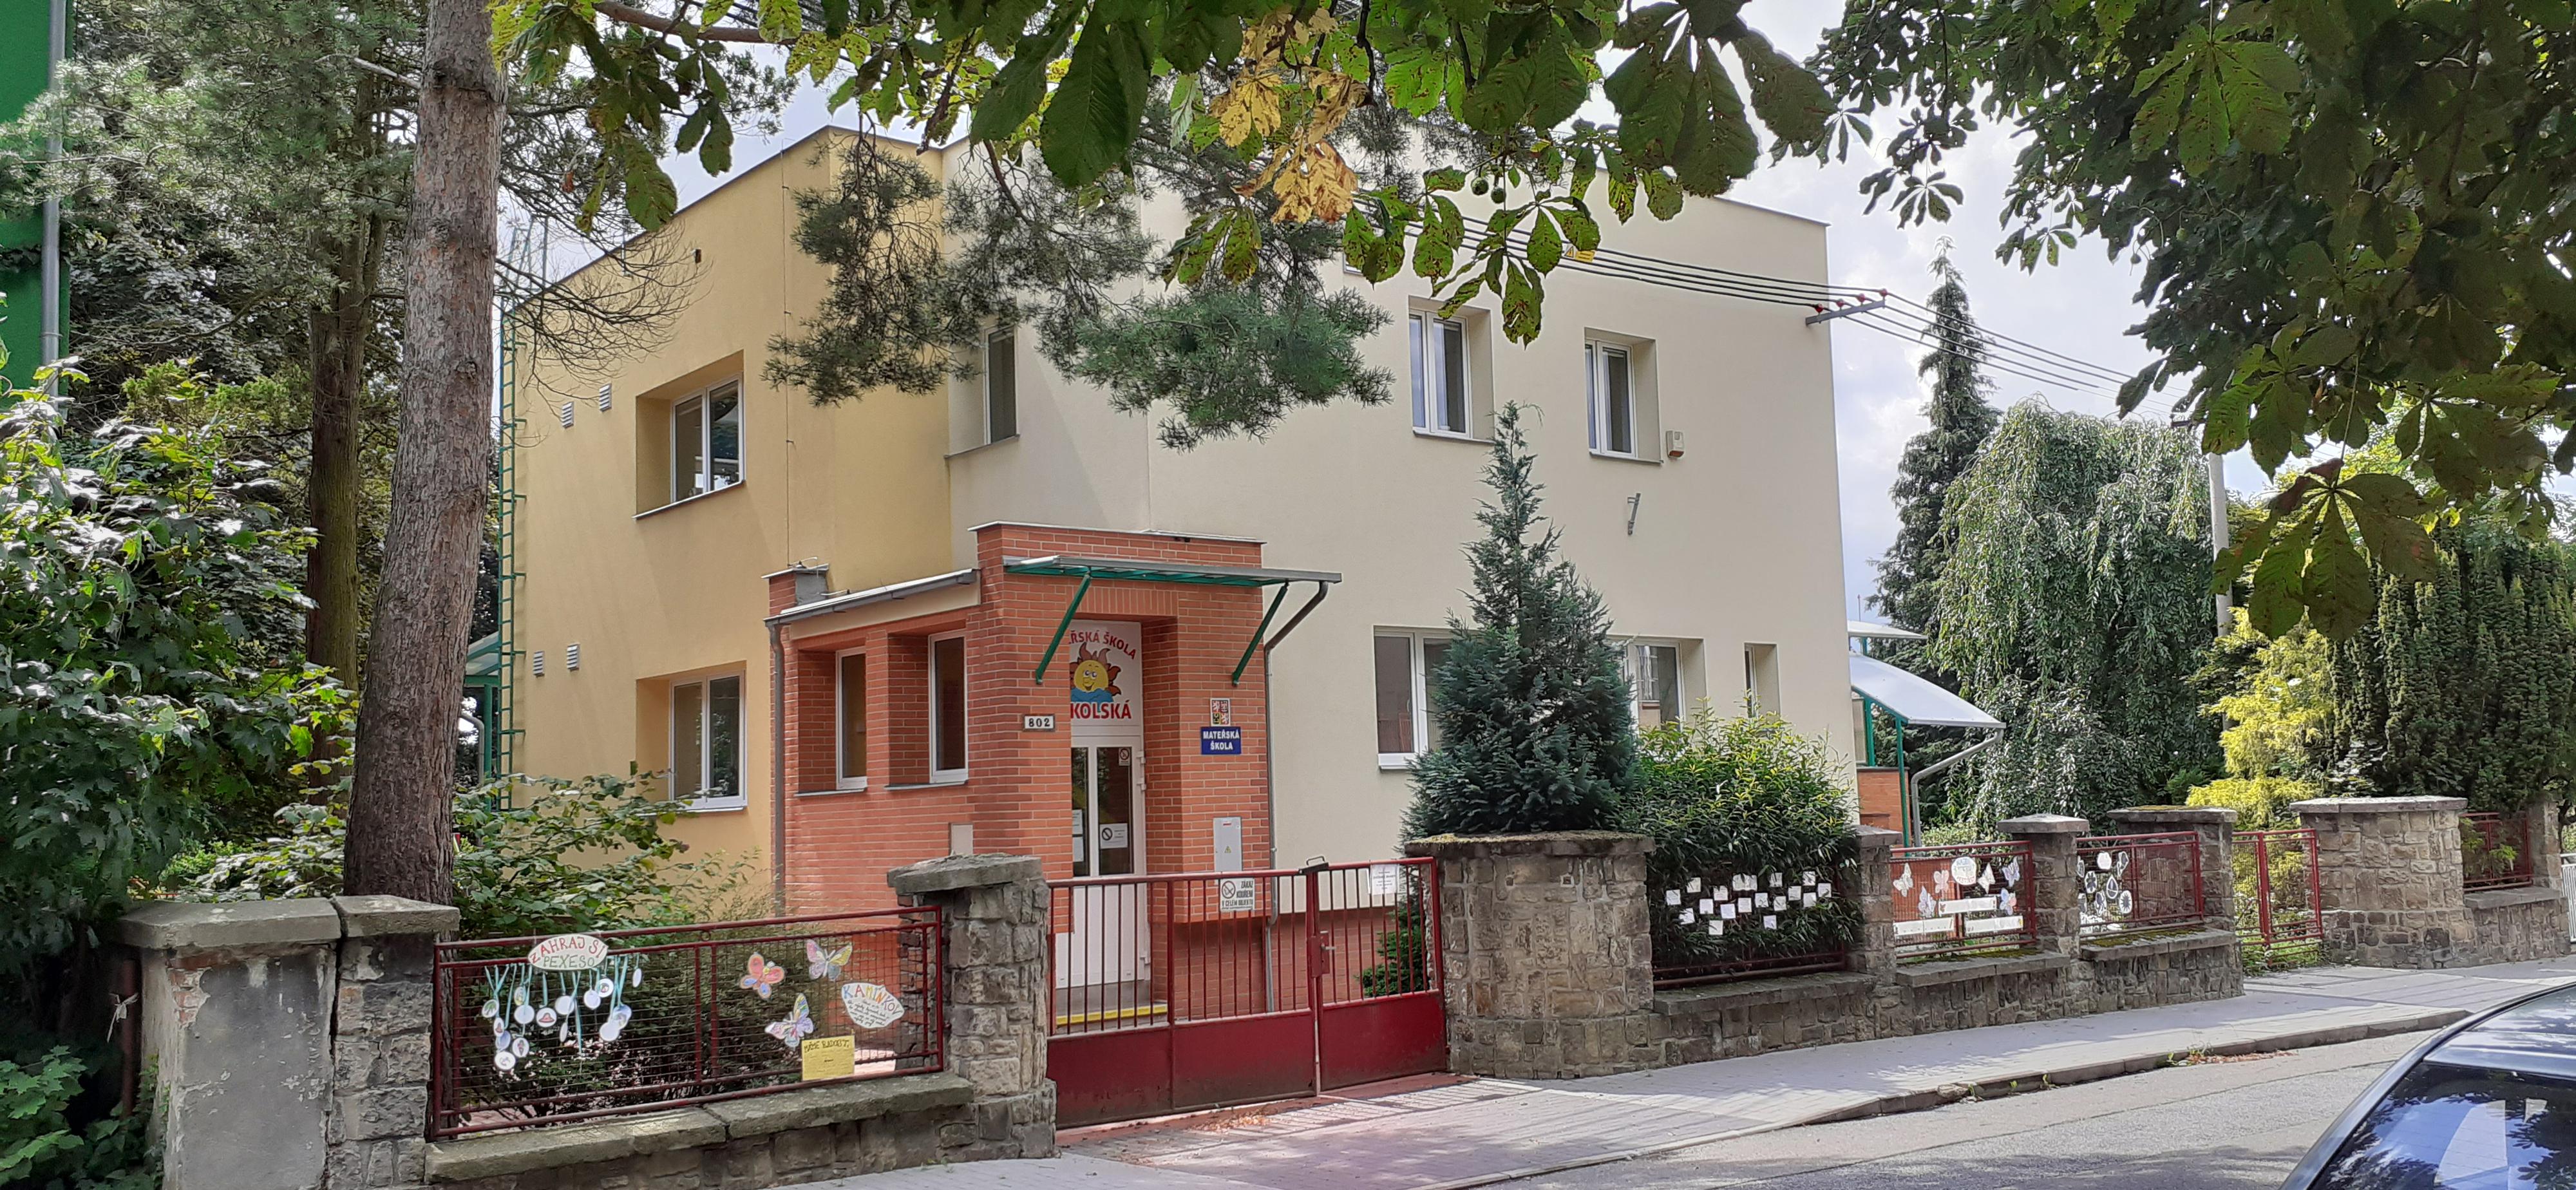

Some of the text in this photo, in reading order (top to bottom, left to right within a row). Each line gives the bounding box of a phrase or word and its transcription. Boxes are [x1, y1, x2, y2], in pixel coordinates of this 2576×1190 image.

[1103, 631, 1136, 659] ŠKOLA
[1028, 717, 1050, 727] 802
[1203, 728, 1240, 739] MATEŘSKÁ
[1210, 740, 1233, 750] ŠKOLA
[529, 936, 605, 964] ZAHRAJ SI
[544, 954, 594, 968] PEXESO
